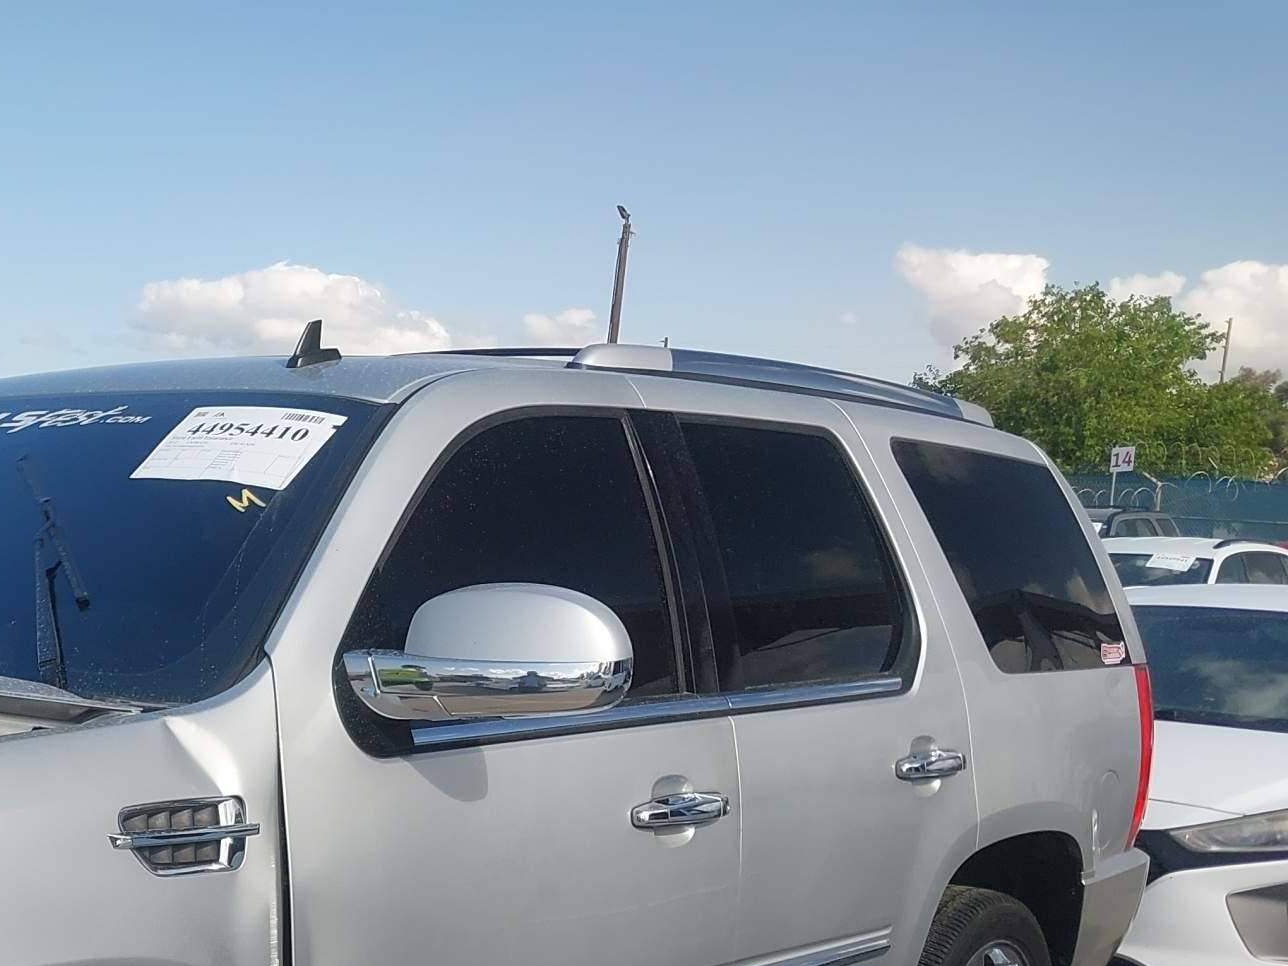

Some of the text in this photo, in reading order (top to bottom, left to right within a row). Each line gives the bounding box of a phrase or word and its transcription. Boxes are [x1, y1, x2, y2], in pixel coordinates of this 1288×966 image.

[187, 422, 310, 442] 44954410
[1111, 451, 1133, 468] 14
[226, 488, 266, 512] M
